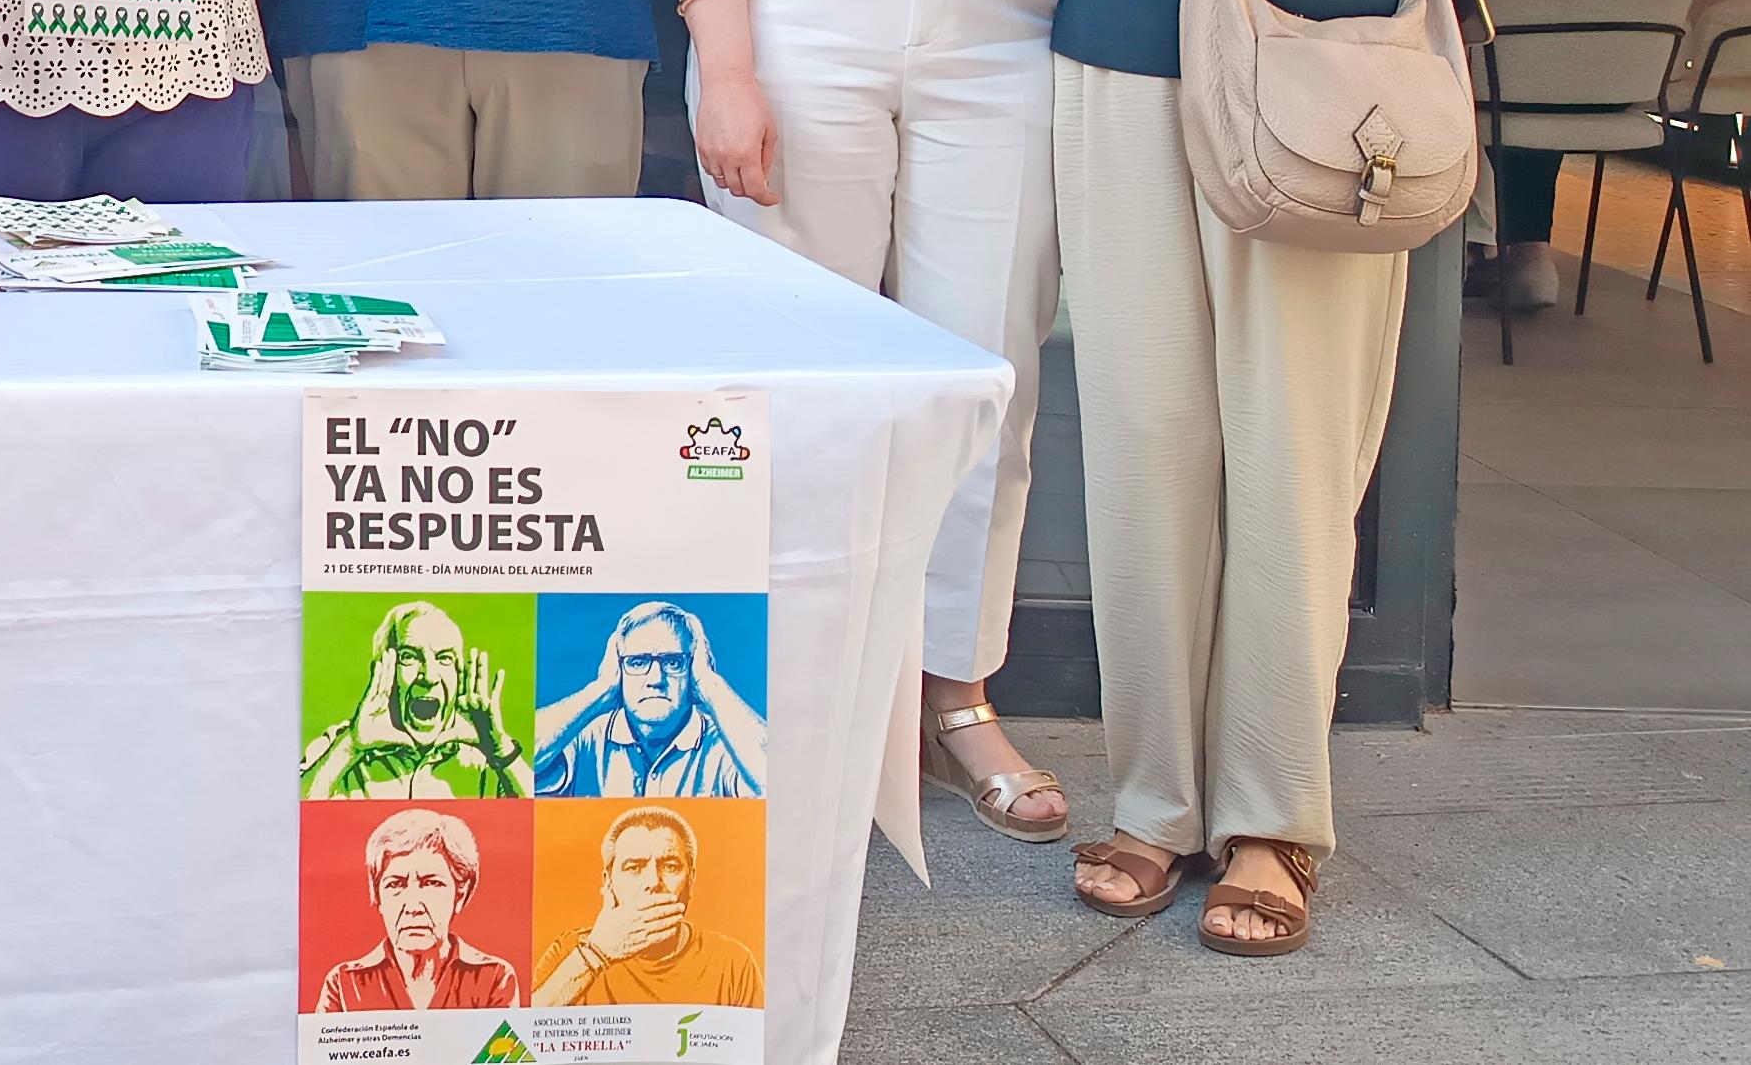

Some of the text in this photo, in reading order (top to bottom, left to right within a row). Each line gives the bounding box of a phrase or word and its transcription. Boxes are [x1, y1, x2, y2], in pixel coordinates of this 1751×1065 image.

[326, 418, 380, 455] EL
[694, 445, 736, 457] CEAFA
[689, 467, 742, 479] ALZHEIMER
[325, 465, 543, 505] YA NO ES
[326, 511, 605, 552] RESPUESTA
[324, 563, 337, 574] 21
[339, 564, 354, 574] DE
[356, 563, 424, 575] SEPTIEMBRE
[432, 562, 451, 575] DÍA
[454, 565, 506, 575] MUNDIAL
[508, 565, 528, 575] DEL
[530, 565, 593, 575] ALZHEIMER
[534, 1017, 573, 1025] ASOCIACION
[593, 1016, 631, 1025] FAMILIARES
[320, 1023, 419, 1035] Confederación Española de
[594, 1028, 632, 1036] ALZHEIMER
[317, 1034, 352, 1045] Alzheimer
[354, 1036, 359, 1044] y
[381, 1032, 422, 1042] Demencias
[328, 1047, 410, 1061] www.ceafa.es
